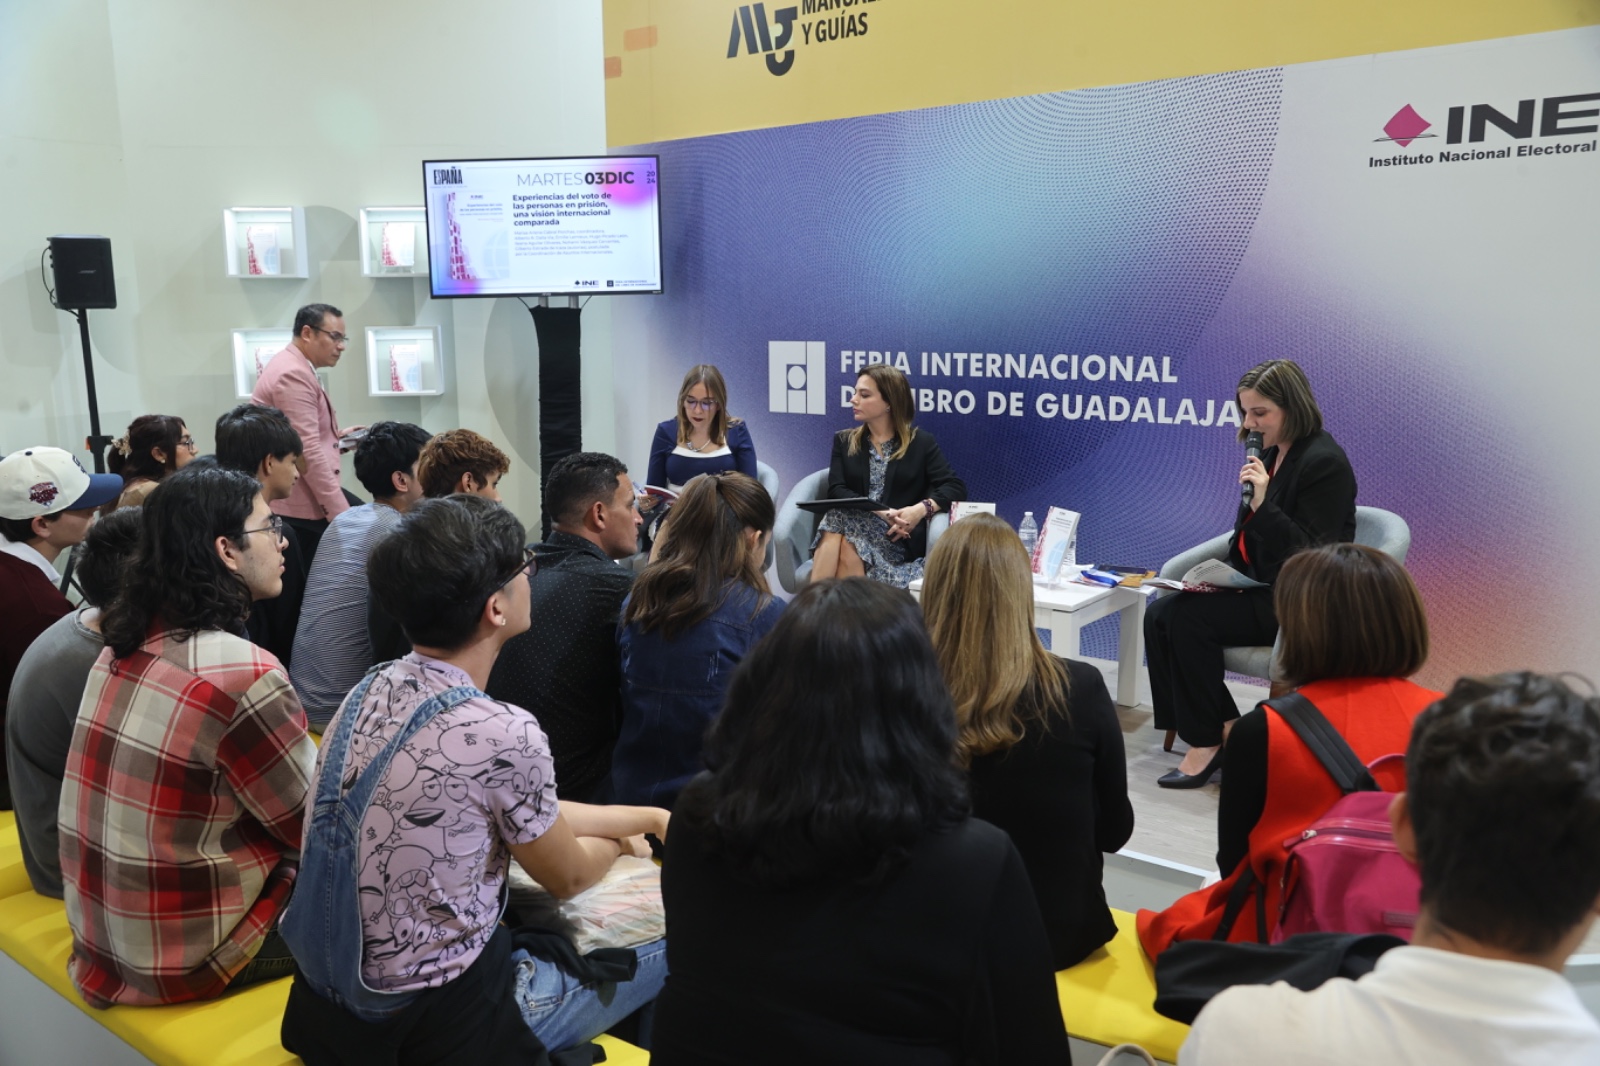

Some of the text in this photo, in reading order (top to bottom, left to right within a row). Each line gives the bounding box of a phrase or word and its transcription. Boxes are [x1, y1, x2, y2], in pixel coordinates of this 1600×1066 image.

[801, 10, 868, 45] Y GUÍAS
[1446, 92, 1600, 145] INE
[1369, 140, 1597, 168] Instituto Nacional Electoral
[433, 166, 463, 185] ESPAÑA
[512, 193, 565, 202] Experiencias
[512, 202, 525, 210] las
[526, 202, 564, 211] personas
[577, 200, 608, 209] prisión,
[513, 218, 560, 228] comparada
[530, 209, 555, 217] visión
[556, 208, 611, 217] internacional
[922, 352, 1178, 383] INTERNACIONAL
[987, 391, 1024, 417] DE
[1035, 392, 1241, 427] GUADALAJA
